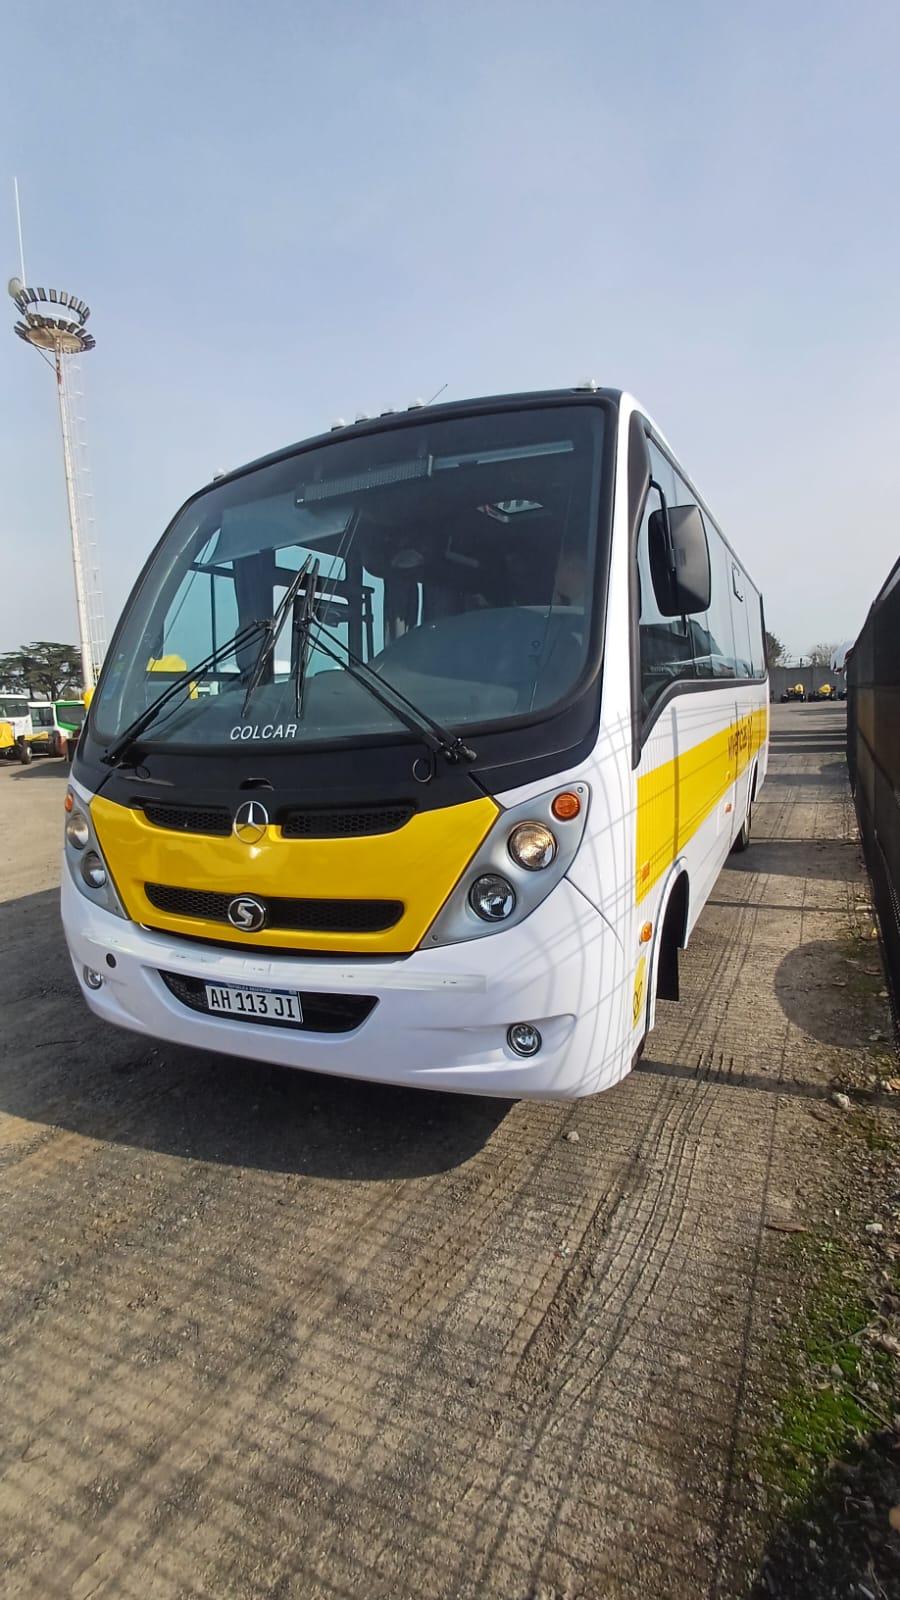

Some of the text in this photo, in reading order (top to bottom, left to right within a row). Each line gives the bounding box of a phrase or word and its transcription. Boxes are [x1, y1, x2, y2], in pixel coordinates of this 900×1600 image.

[230, 724, 298, 740] COLCAR
[210, 988, 296, 1018] AH 113 JI
